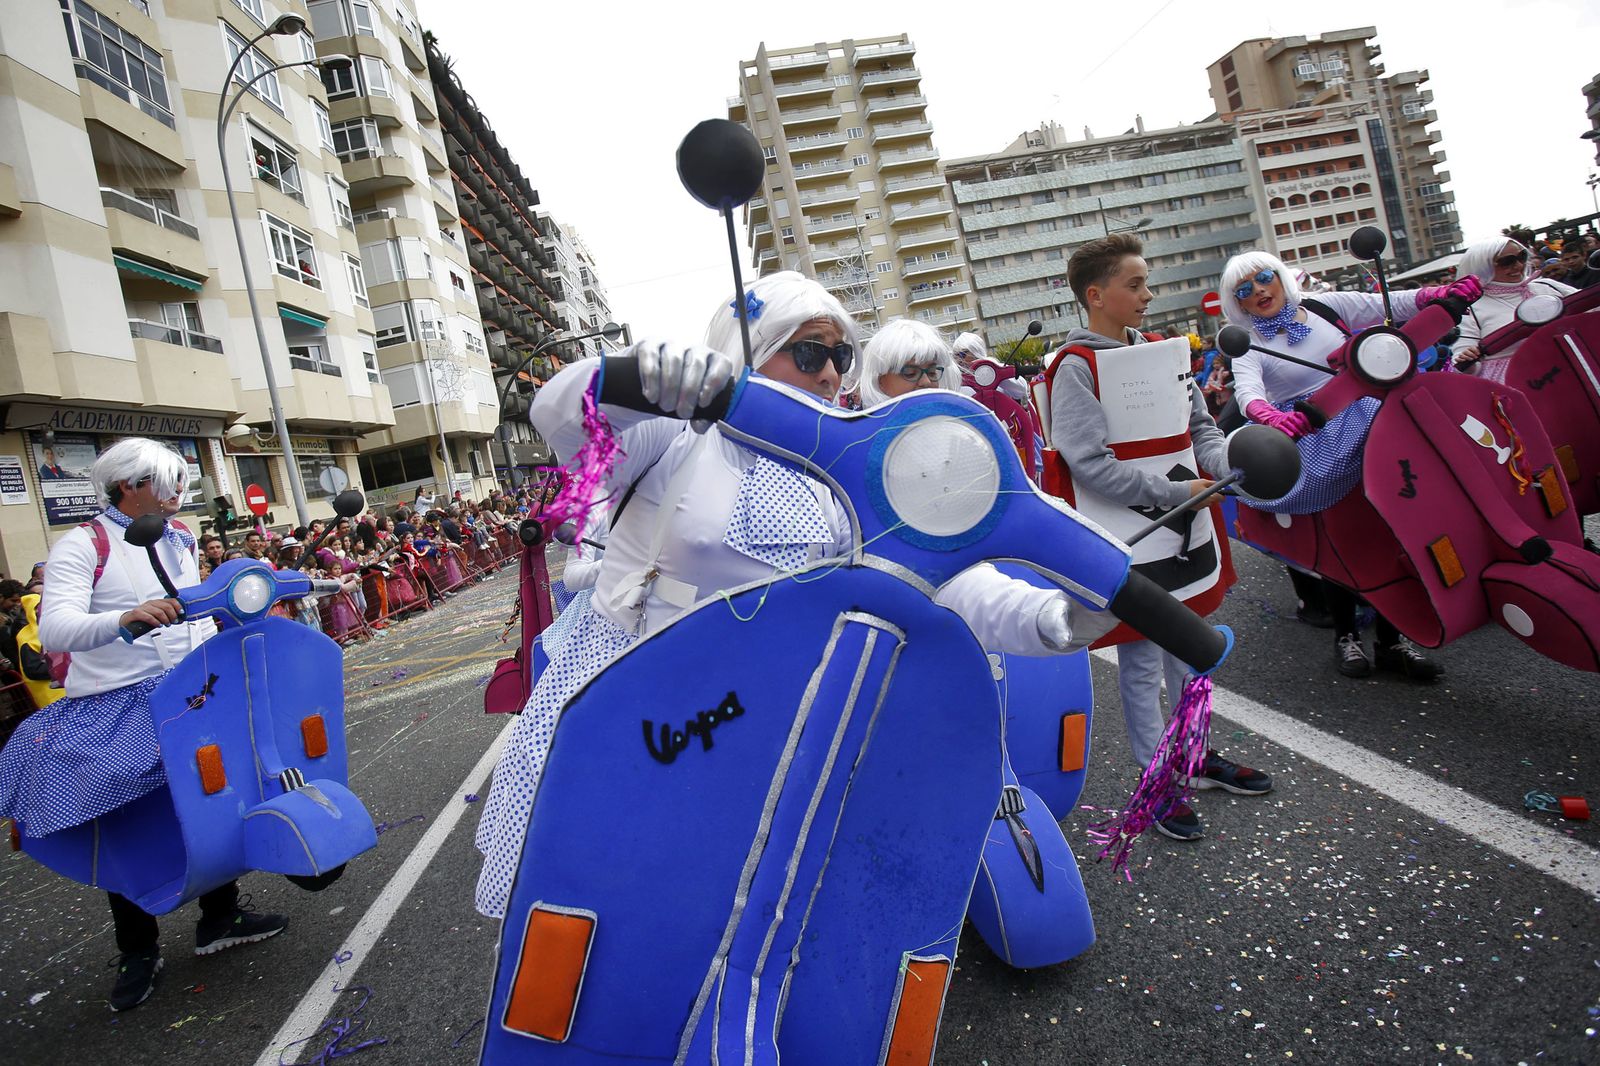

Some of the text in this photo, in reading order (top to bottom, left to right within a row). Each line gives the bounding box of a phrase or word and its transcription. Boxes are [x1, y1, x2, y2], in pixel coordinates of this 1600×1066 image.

[1121, 380, 1152, 388] TOTAL
[48, 409, 133, 431] ACADEMIA
[138, 415, 157, 432] DE
[258, 440, 294, 448] Gestn
[1398, 458, 1417, 498] Vespa
[56, 496, 97, 506] 900 100 405
[642, 691, 745, 765] Vespa
